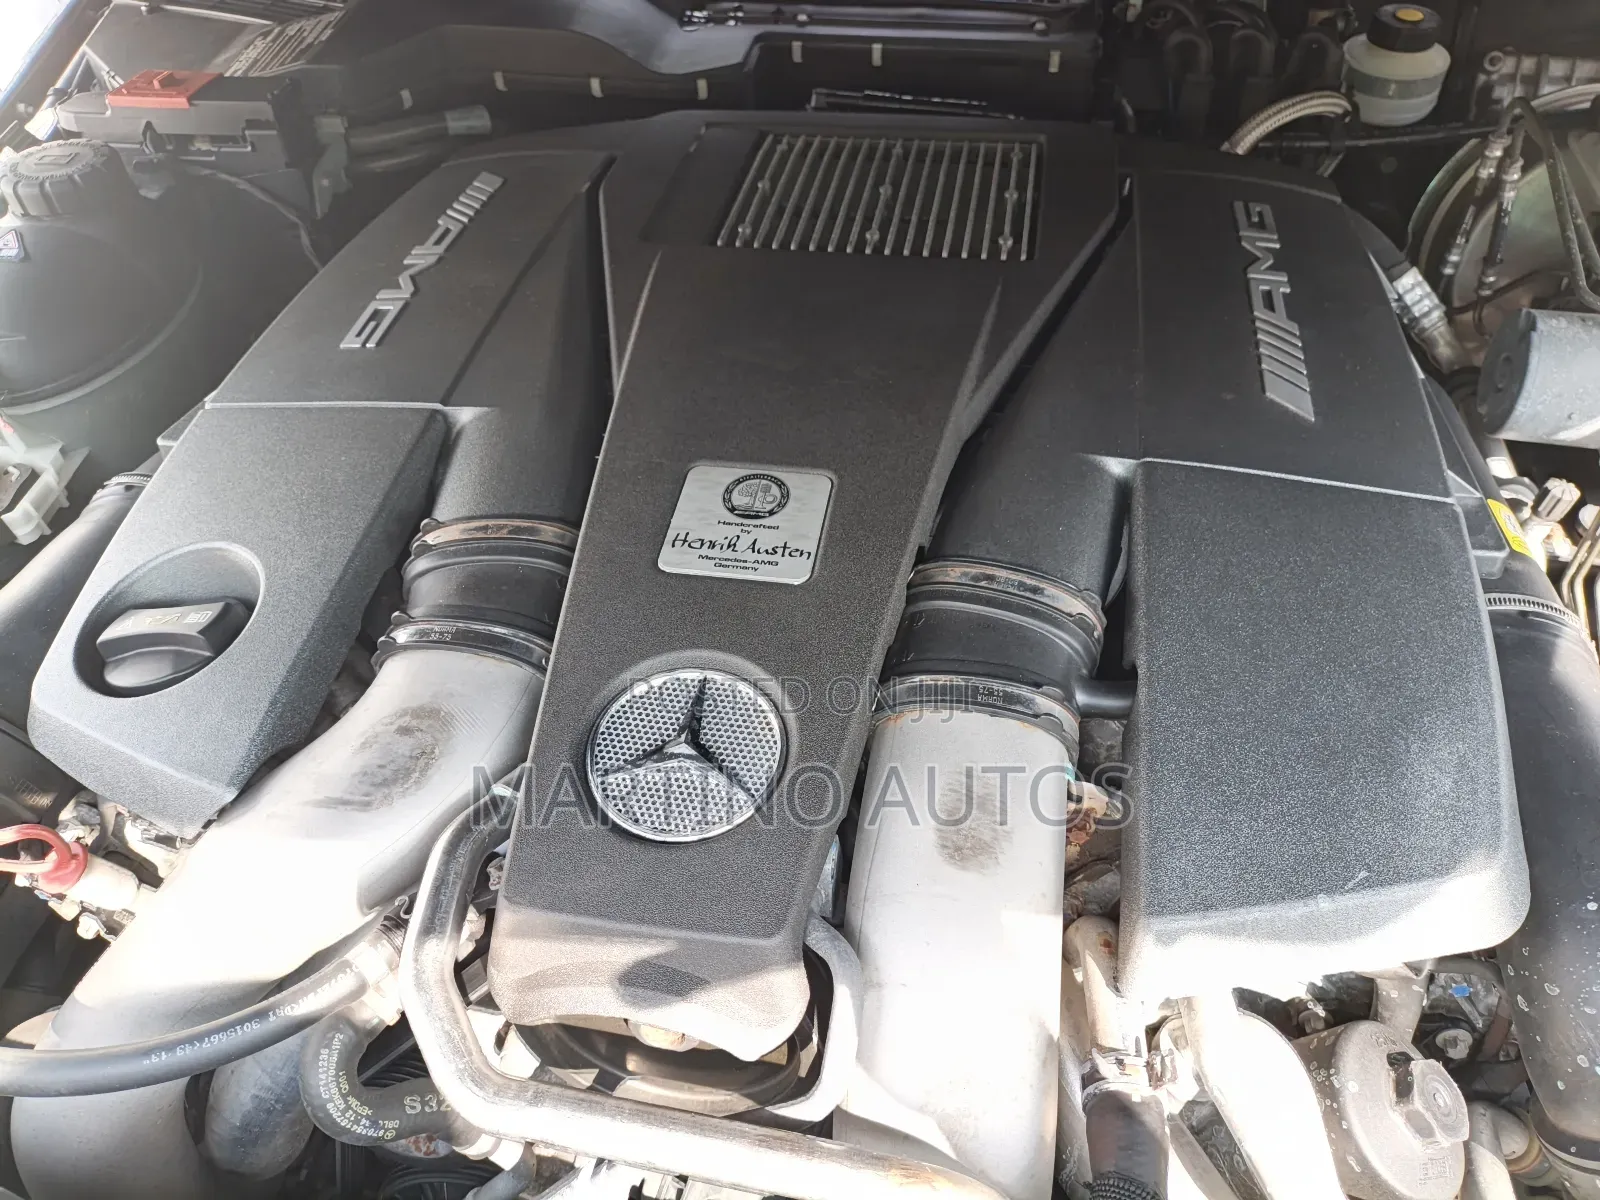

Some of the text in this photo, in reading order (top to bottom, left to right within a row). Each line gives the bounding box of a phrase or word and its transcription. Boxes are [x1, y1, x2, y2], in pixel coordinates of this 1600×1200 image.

[717, 520, 779, 530] Handcrafted
[698, 554, 779, 567] Mercedes-AMG
[714, 562, 759, 572] Germany
